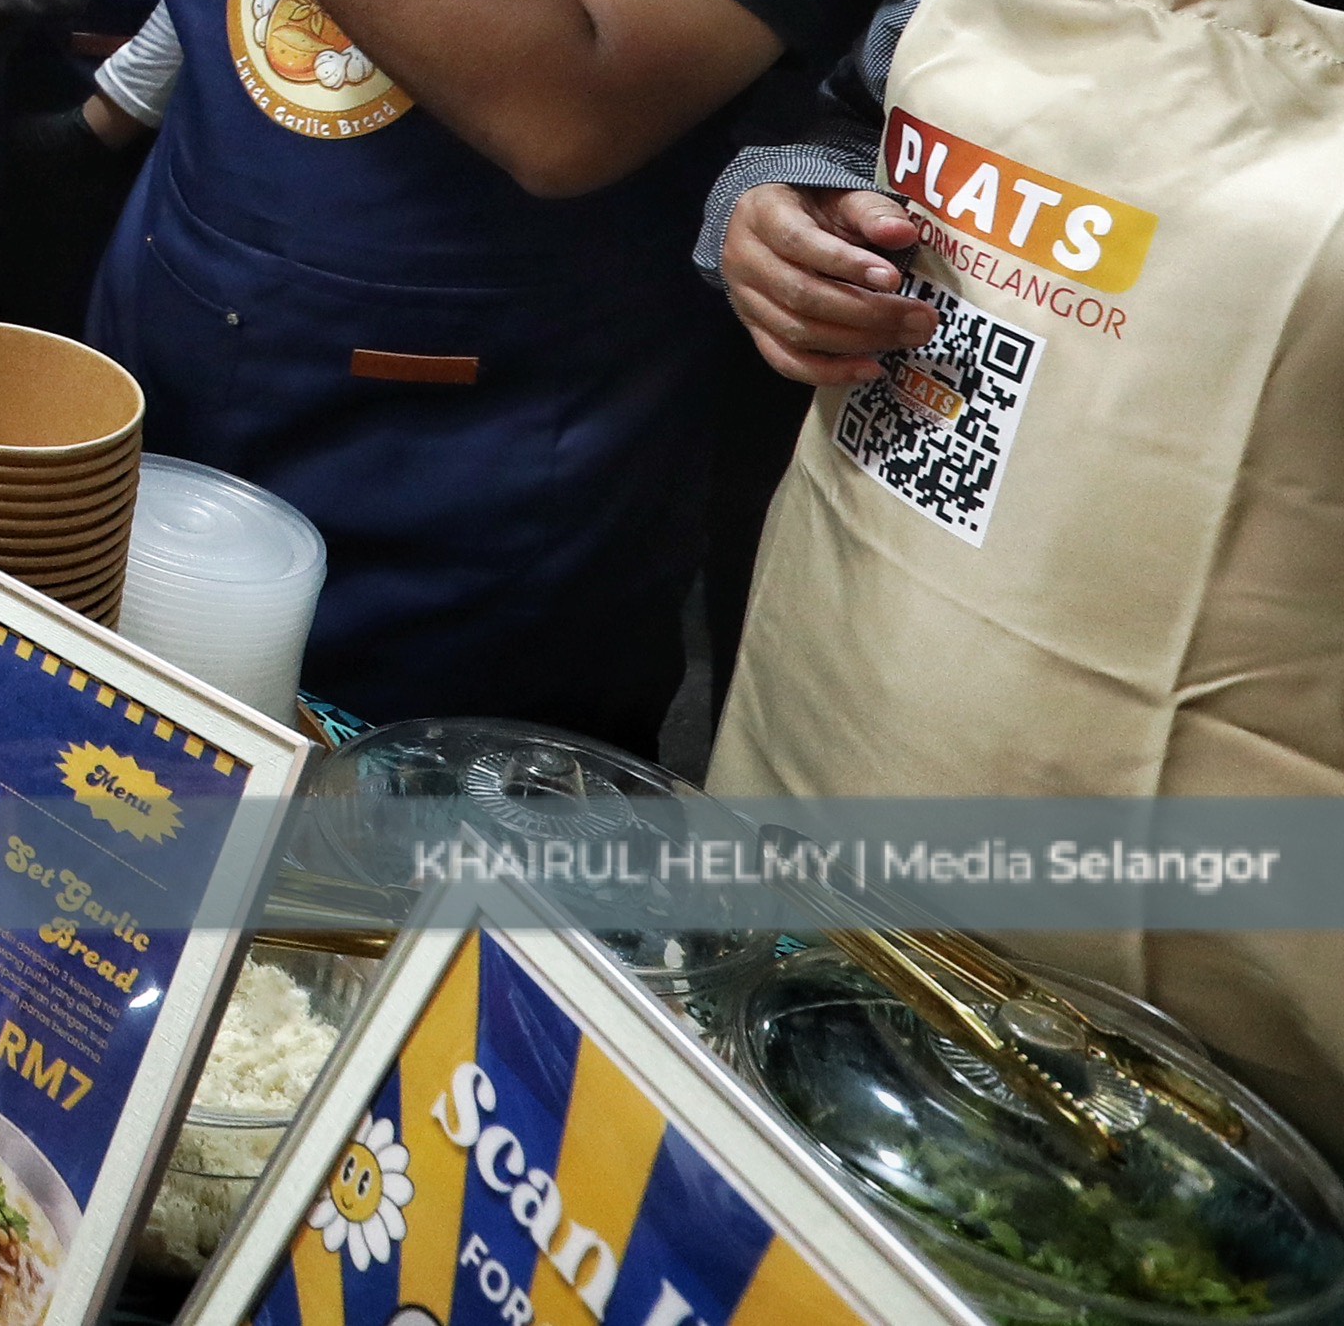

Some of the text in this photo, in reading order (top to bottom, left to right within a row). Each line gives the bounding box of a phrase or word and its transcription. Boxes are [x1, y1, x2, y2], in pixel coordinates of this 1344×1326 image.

[274, 105, 330, 137] Garlic
[339, 100, 397, 136] Bread
[894, 123, 1113, 272] PLATS
[896, 365, 955, 414] PLATS
[85, 765, 152, 816] Menu
[5, 836, 150, 952] Set Garlic
[38, 917, 140, 994] Bread
[50, 985, 75, 1008] yang
[431, 1062, 619, 1324] Scan
[460, 1232, 535, 1326] FOR
